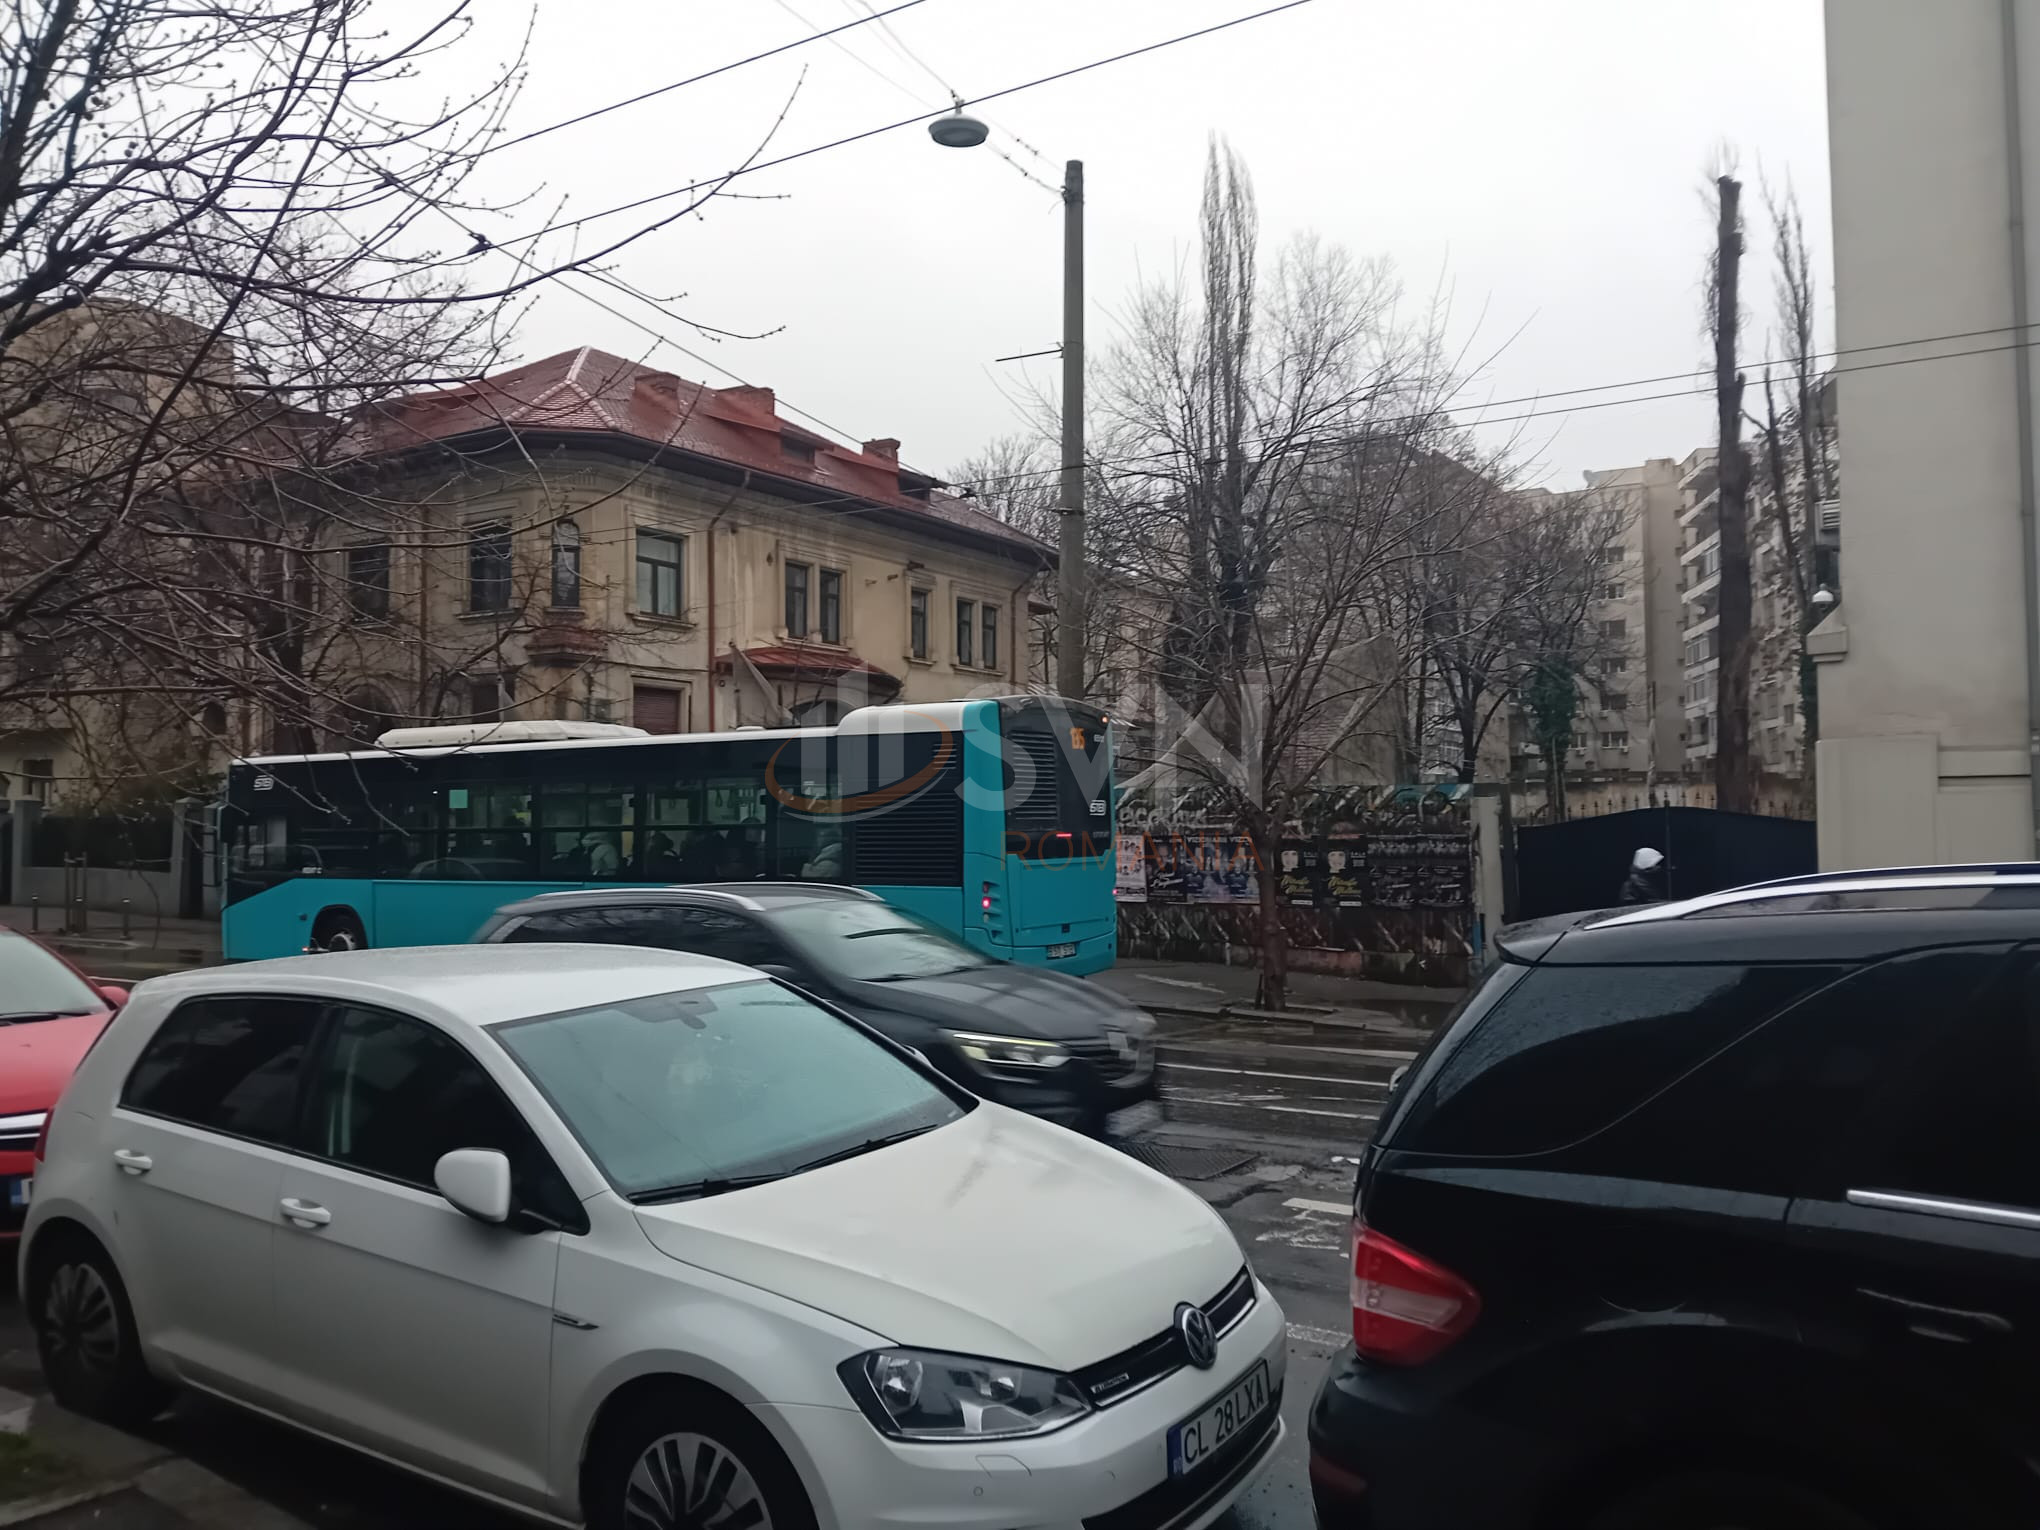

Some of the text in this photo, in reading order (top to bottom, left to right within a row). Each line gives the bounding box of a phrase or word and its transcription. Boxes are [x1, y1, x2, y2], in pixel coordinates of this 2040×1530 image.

[1184, 1374, 1264, 1464] CL 28 LXA
